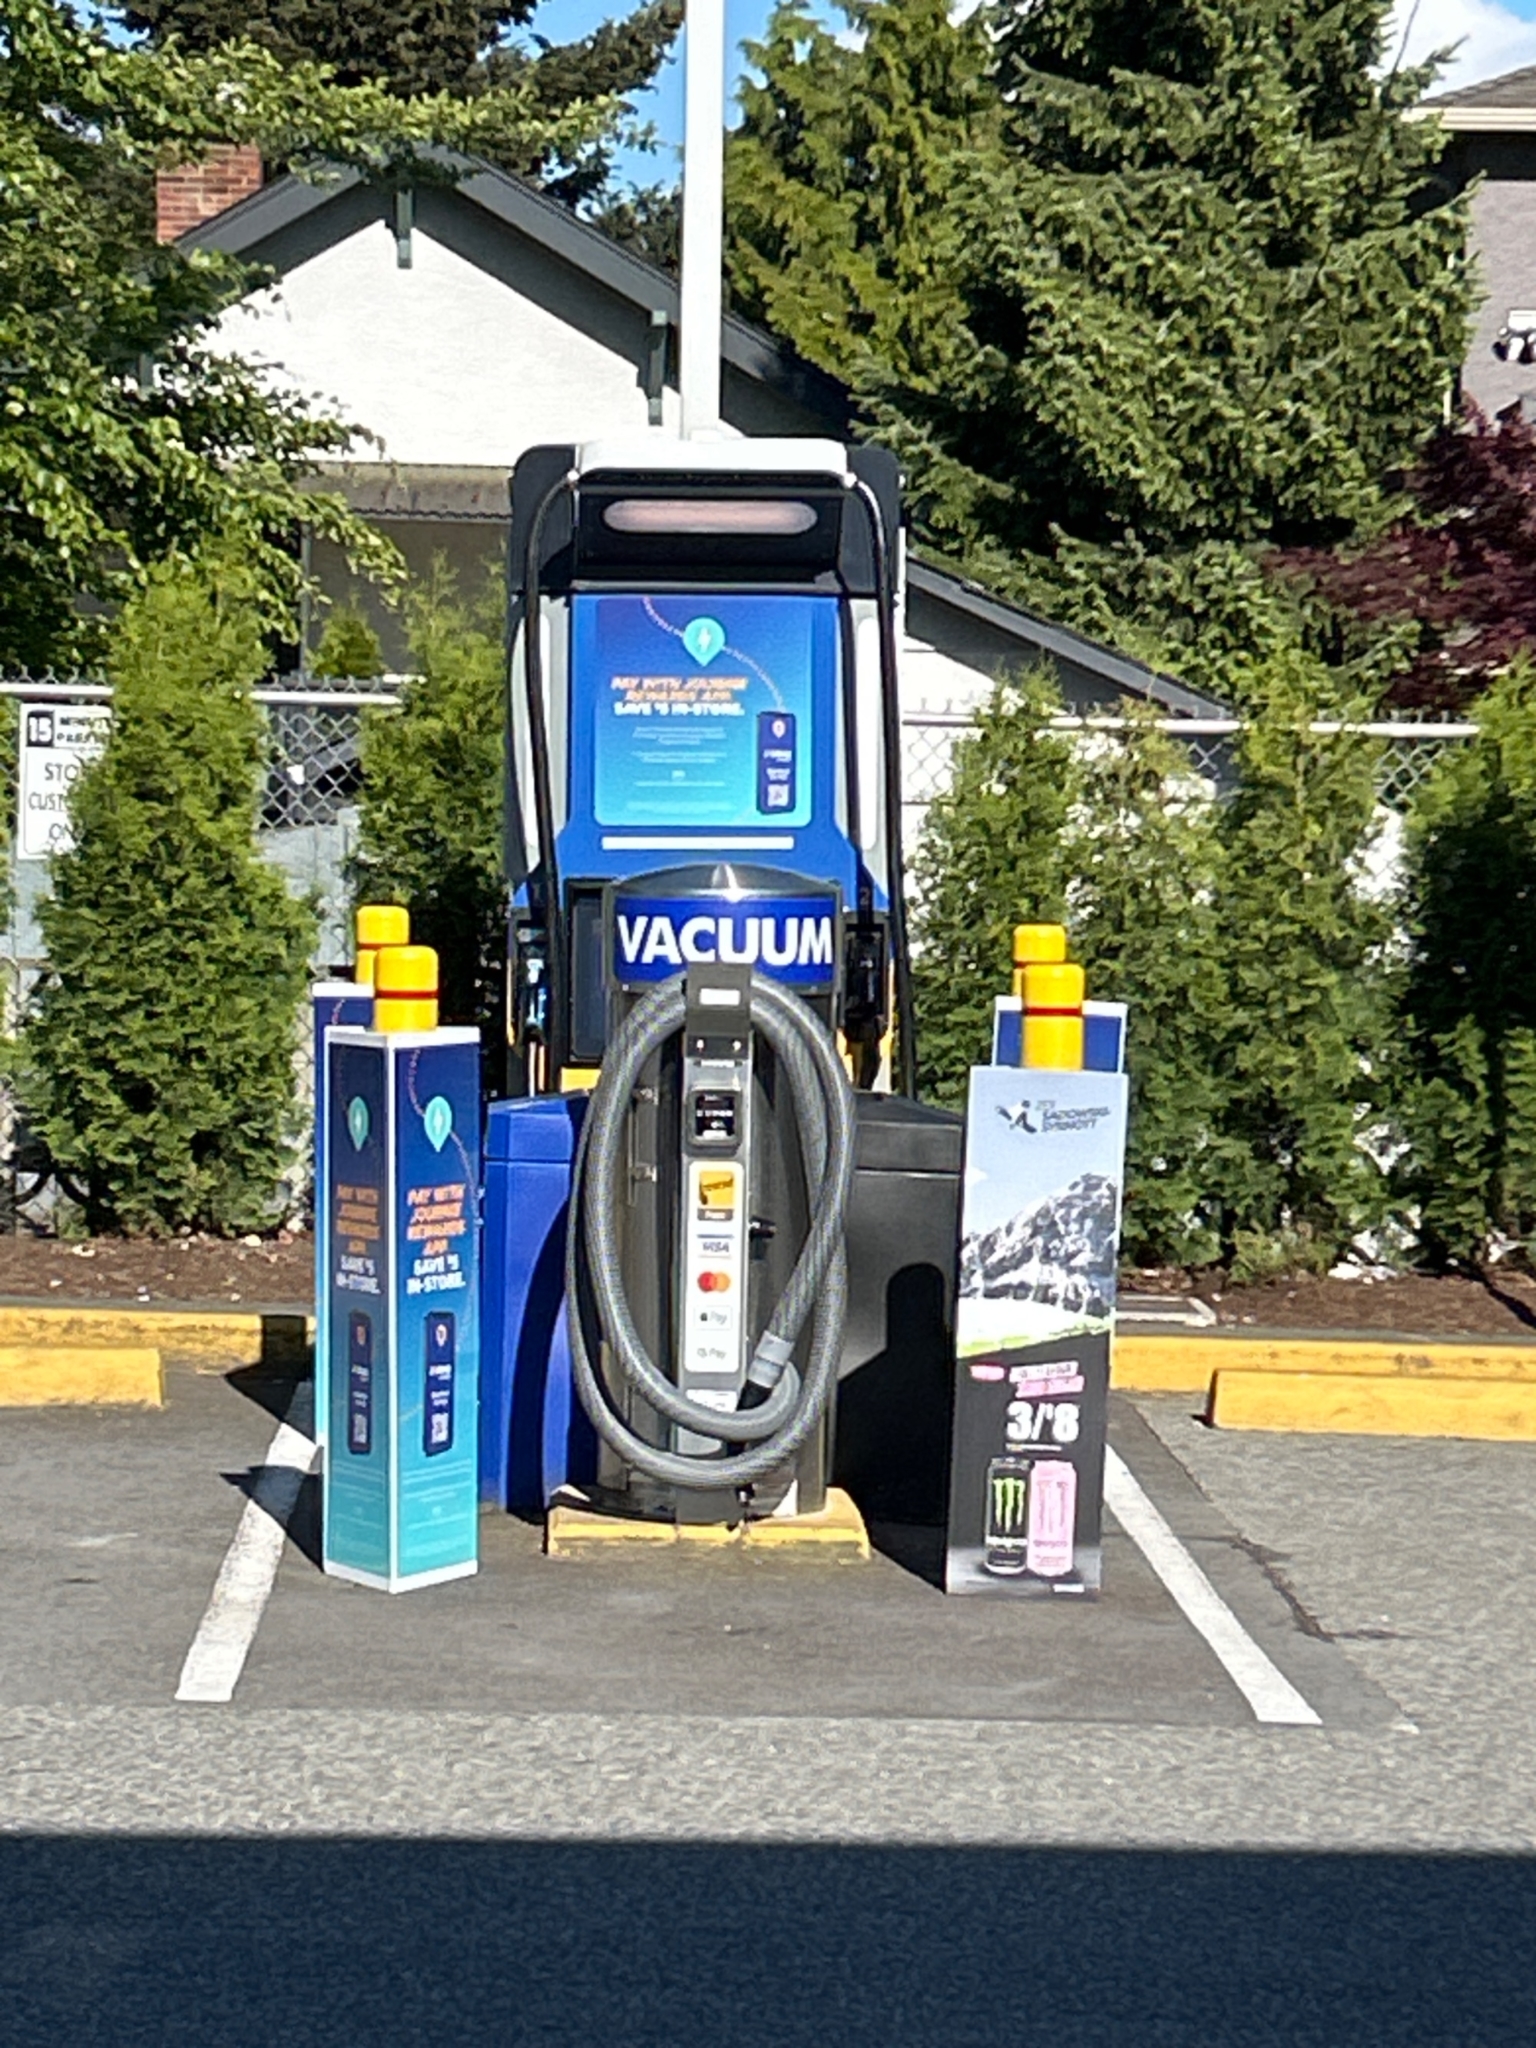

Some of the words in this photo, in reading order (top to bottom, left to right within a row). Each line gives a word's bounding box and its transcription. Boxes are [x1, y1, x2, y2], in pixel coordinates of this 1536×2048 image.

[28, 716, 53, 743] 15
[45, 763, 80, 782] STO
[617, 914, 833, 966] VACUUM
[702, 1241, 729, 1254] VISA
